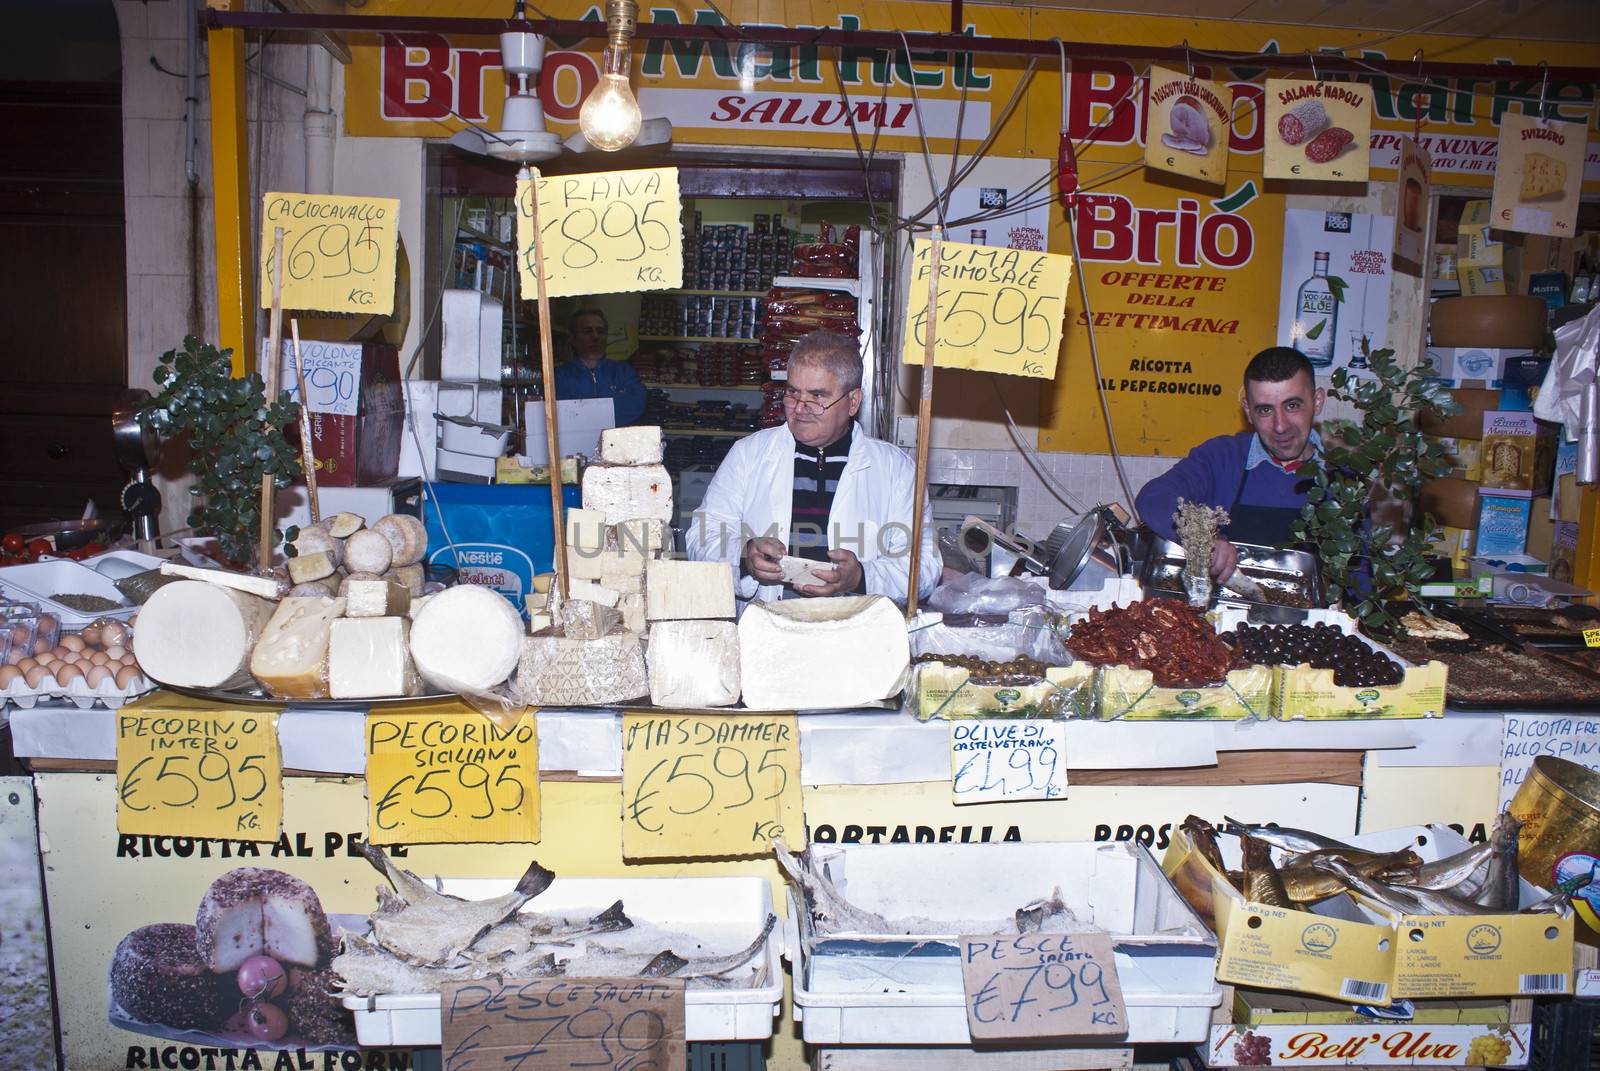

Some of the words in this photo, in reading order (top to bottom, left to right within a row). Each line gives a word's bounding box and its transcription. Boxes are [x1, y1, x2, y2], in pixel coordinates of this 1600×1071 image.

[1324, 86, 1363, 108] NAPOLI
[710, 95, 914, 129] SALUMI
[1435, 138, 1498, 156] NUNZ
[1521, 128, 1565, 146] SVIZZERO
[268, 198, 386, 220] CACIOCAVALLO
[1074, 182, 1258, 268] Brió
[1031, 256, 1048, 272] E
[1101, 271, 1227, 292] OFFERTE
[1127, 293, 1195, 307] DELLA
[1303, 302, 1332, 311] ALOE
[1077, 311, 1240, 334] SETTIMANA
[1129, 359, 1192, 373] RICOTTA
[1120, 379, 1221, 396] PEPERONCINO
[121, 716, 257, 738] PECORINO
[370, 720, 533, 754] PECORINO
[627, 719, 790, 751] MASDAMMER
[954, 725, 1017, 740] OLIVE
[1024, 726, 1044, 738] DI
[1507, 718, 1573, 737] RICOTTA
[151, 737, 238, 751] INTERO
[953, 738, 1055, 751] CASTELVETRANO
[1505, 742, 1541, 759] ALLO
[1545, 738, 1600, 757] SPIN
[415, 748, 516, 767] SICILIANO
[117, 833, 260, 858] RICOTTA
[271, 832, 314, 858] AL
[1431, 920, 1446, 928] NET
[968, 936, 1073, 963] PESCE
[450, 981, 584, 1024] PESCE
[1382, 1030, 1463, 1060] Uva
[126, 1045, 265, 1071] RICOTTA
[273, 1047, 314, 1071] AL
